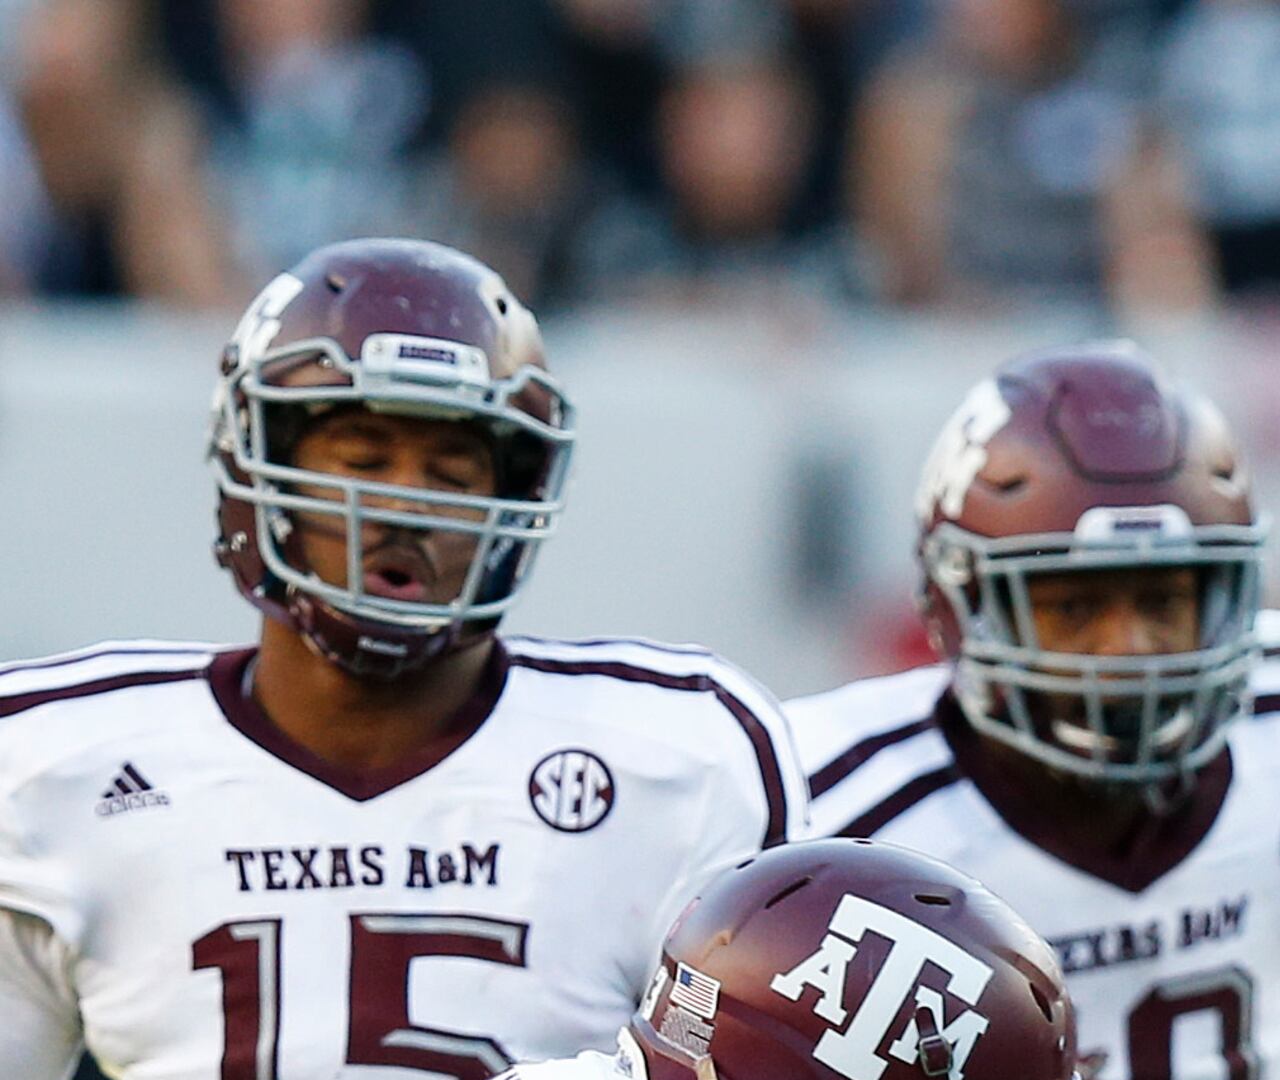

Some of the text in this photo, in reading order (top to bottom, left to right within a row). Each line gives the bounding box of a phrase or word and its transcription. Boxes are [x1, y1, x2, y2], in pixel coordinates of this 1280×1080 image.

[529, 750, 615, 833] SEC
[226, 844, 501, 891] TEXAS A&M
[1048, 920, 1163, 974] EXAS
